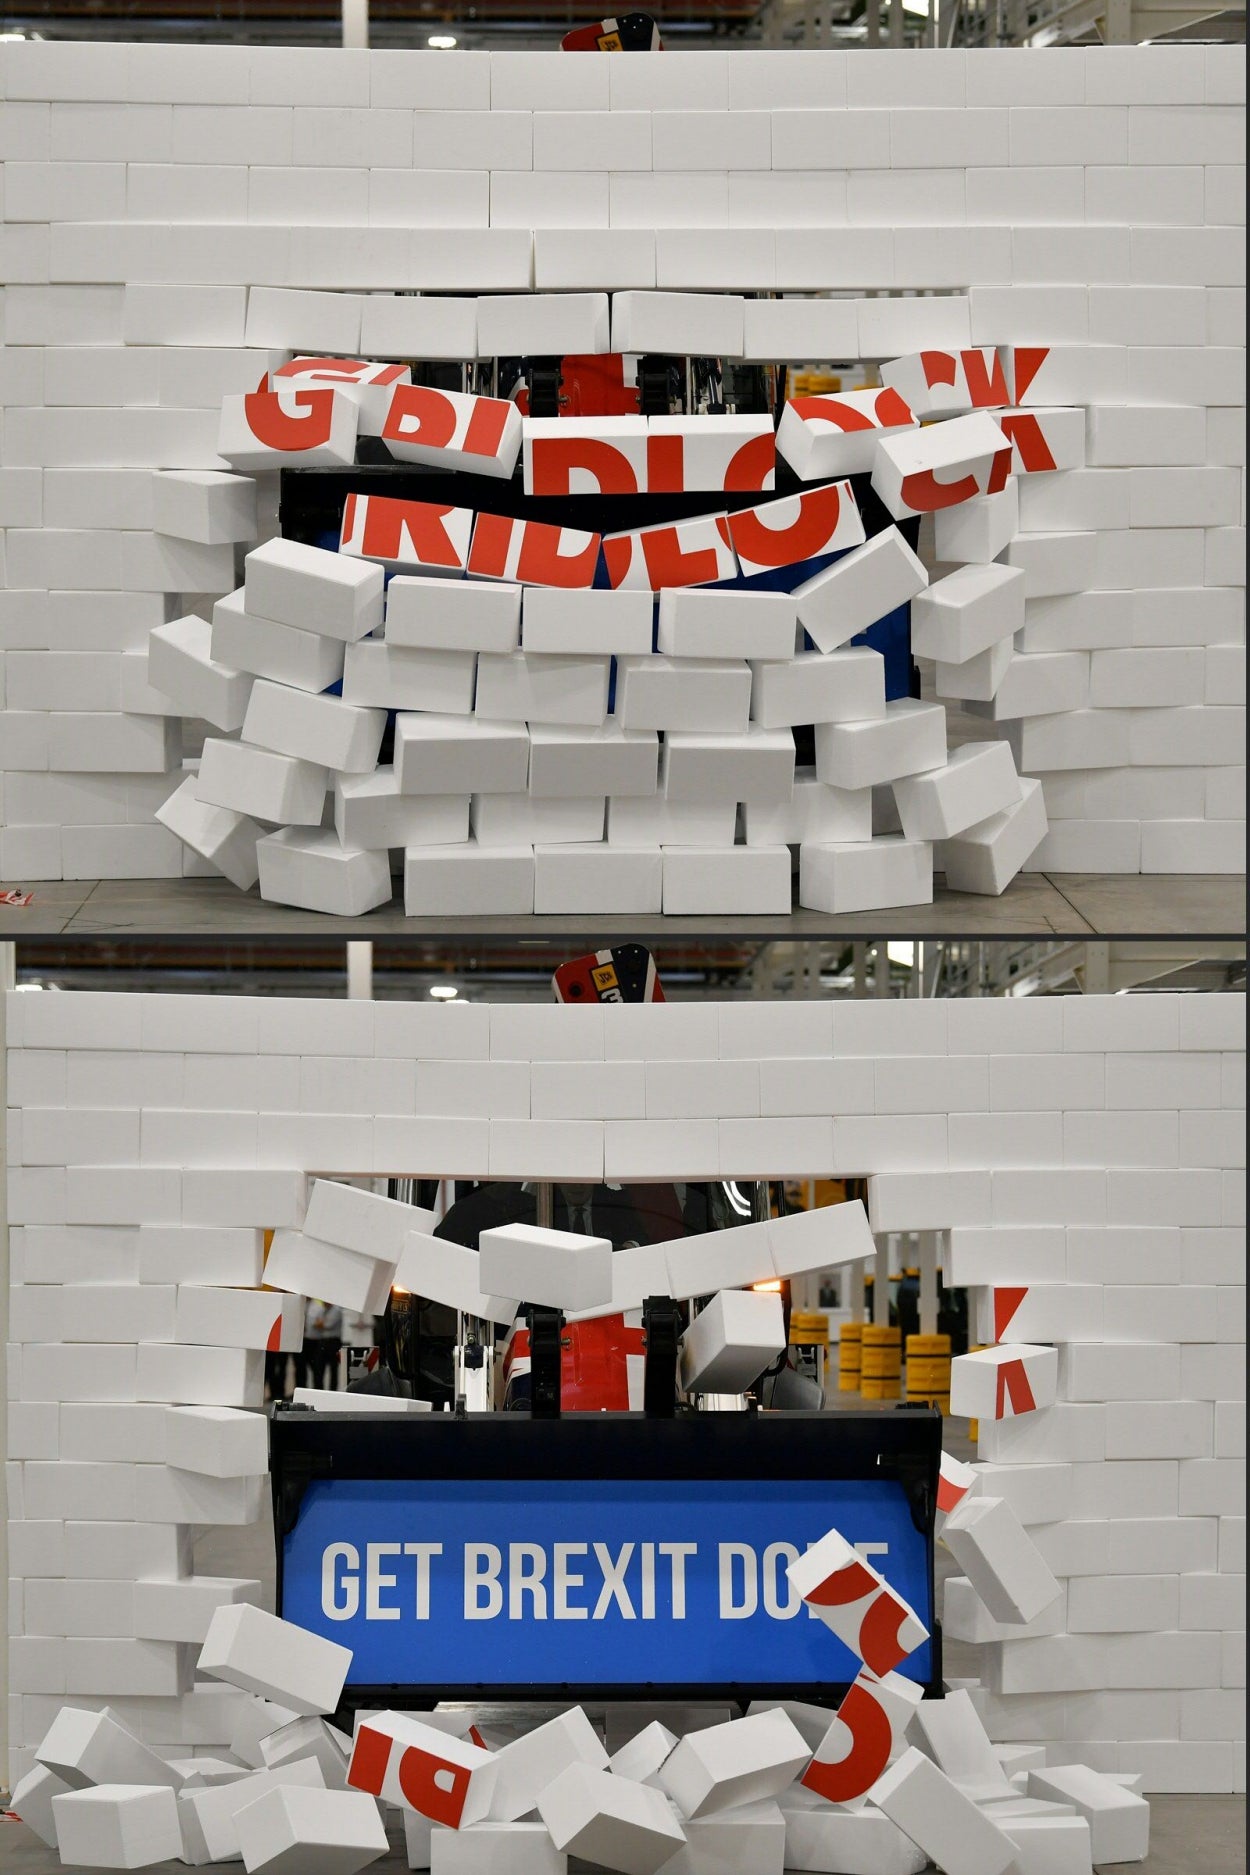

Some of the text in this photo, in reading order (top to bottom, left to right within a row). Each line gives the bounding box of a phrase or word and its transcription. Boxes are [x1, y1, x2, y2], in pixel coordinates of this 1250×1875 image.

[321, 1542, 443, 1620] GET
[463, 1542, 698, 1620] BREXIT
[719, 1542, 889, 1620] DO
